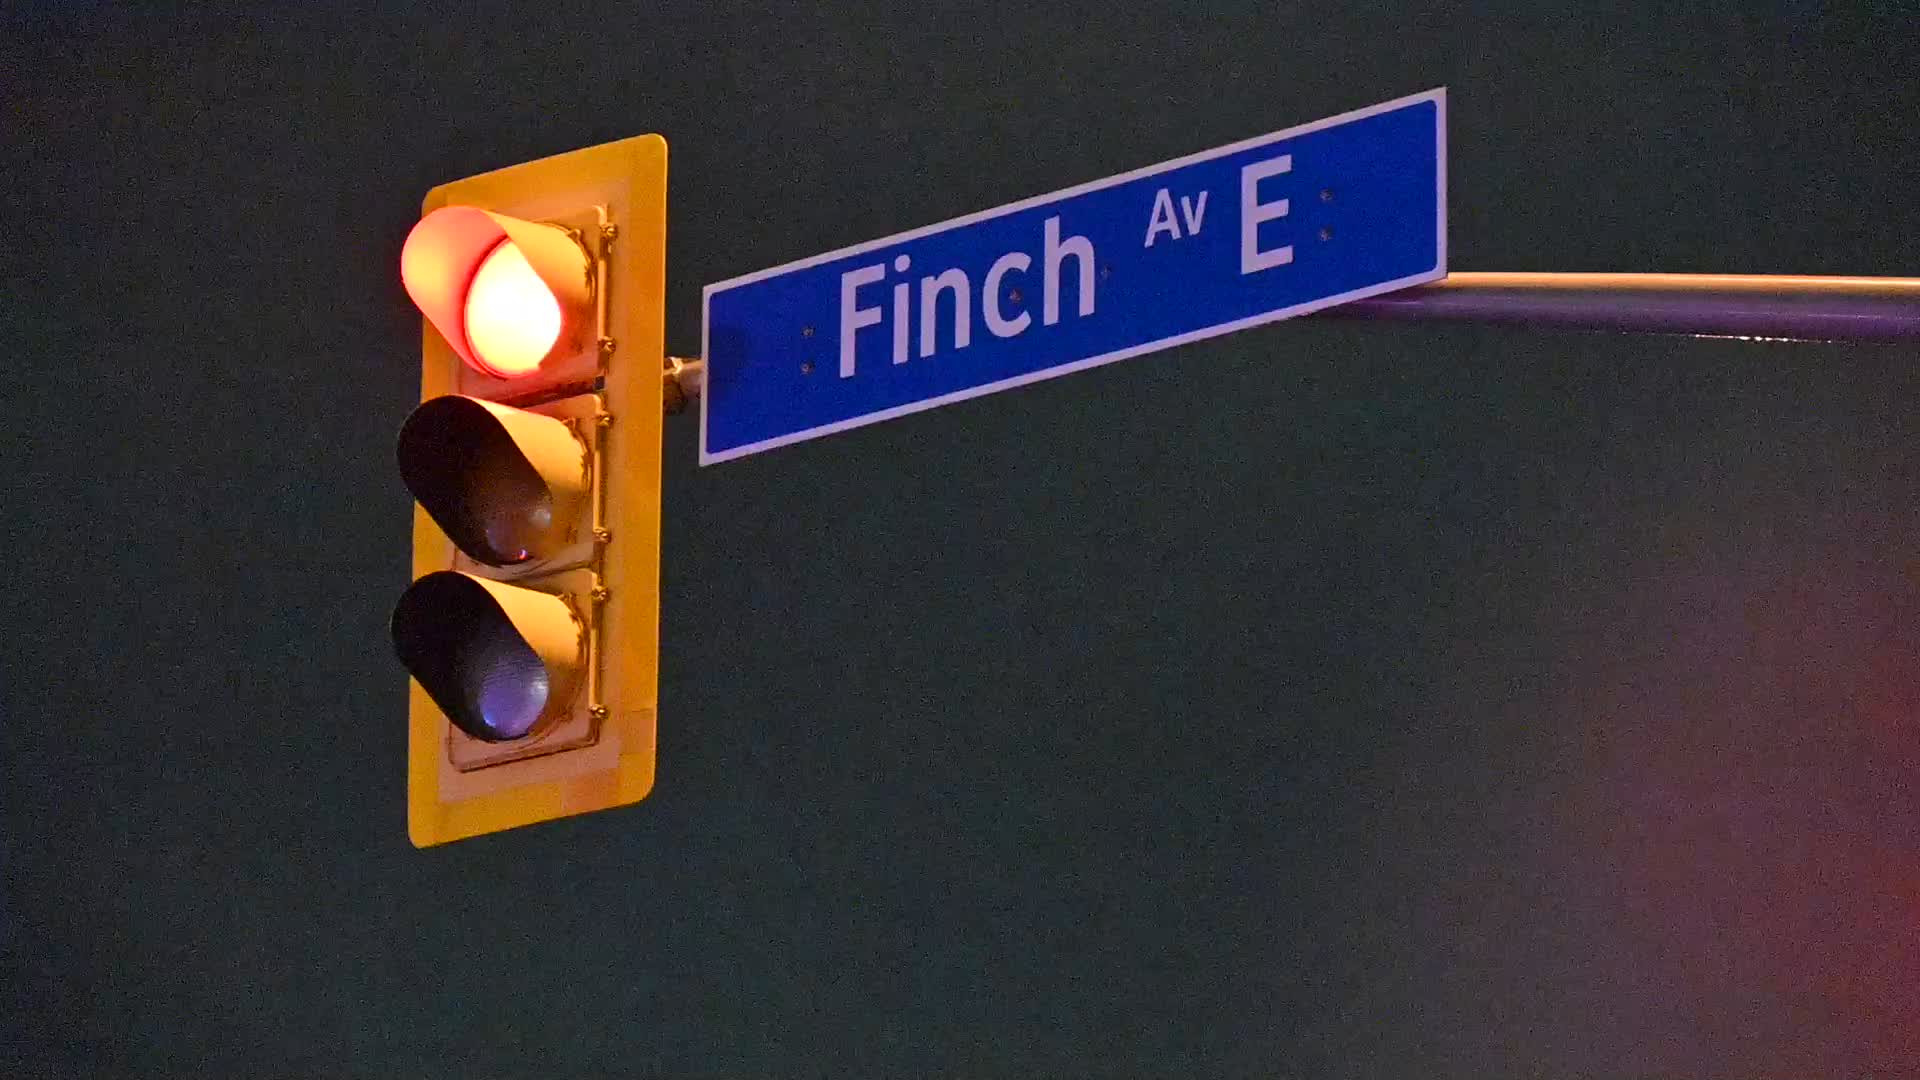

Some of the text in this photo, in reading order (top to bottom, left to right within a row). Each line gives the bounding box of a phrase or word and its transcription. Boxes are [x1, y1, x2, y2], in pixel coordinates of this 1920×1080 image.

[839, 154, 1293, 378] Finch Av E
